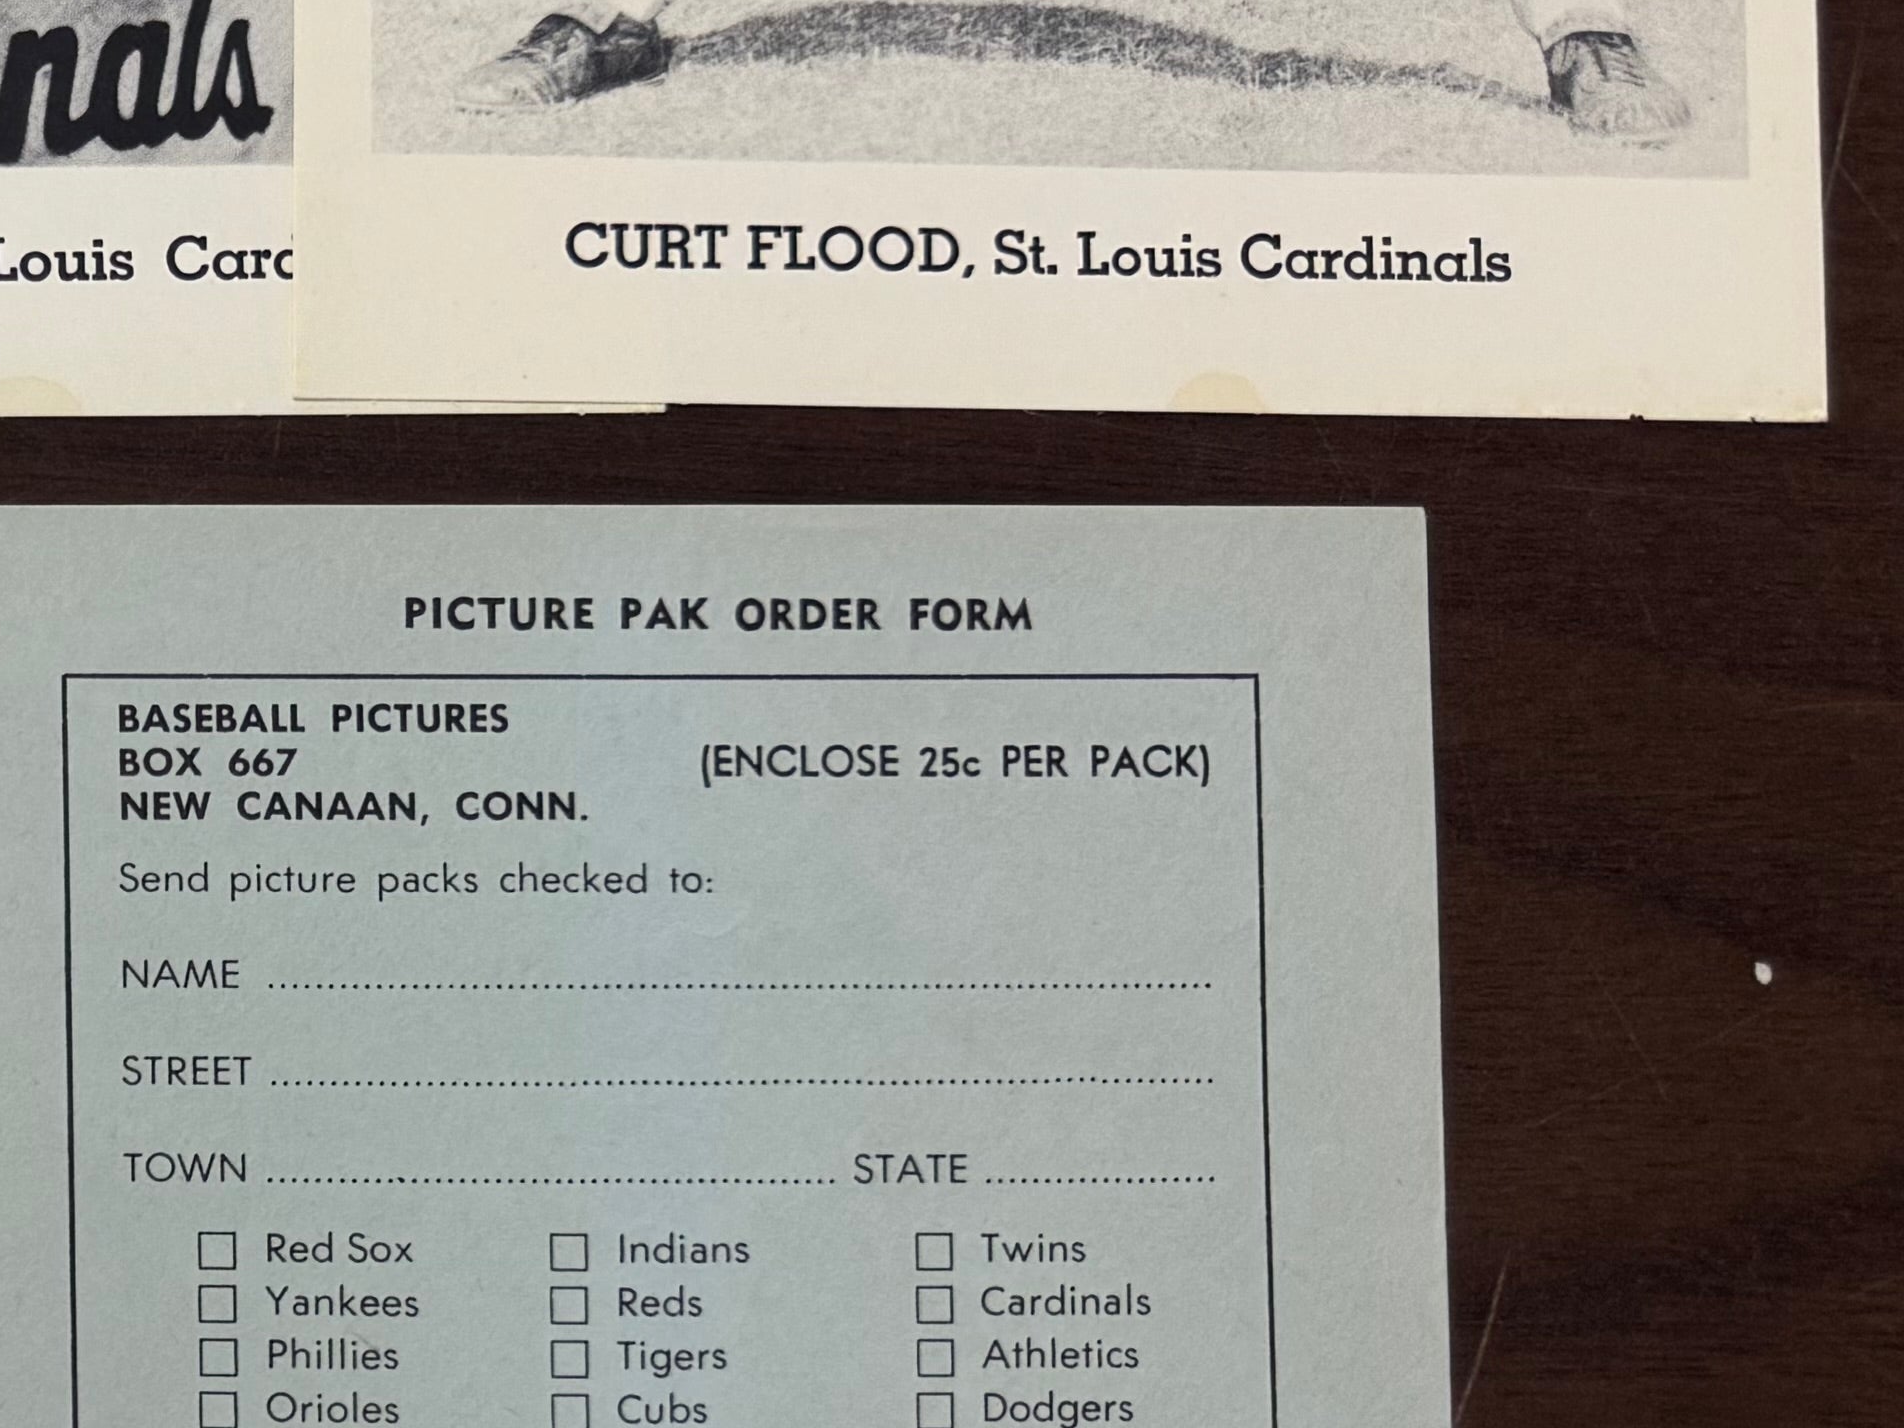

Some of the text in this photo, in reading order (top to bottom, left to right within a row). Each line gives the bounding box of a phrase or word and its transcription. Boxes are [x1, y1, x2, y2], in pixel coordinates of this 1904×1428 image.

[564, 220, 1513, 284] CURT FLOOD, St. Louis Cardinals
[404, 595, 1033, 633] PICTURE PAK ORDER FORM
[117, 702, 509, 734] BASEBALL PICTURES
[118, 746, 298, 778] BOX 667
[700, 743, 1210, 789] (ENCLOSE 25c PER PACK)
[120, 790, 589, 827] NEW CANAAN, CONN.
[118, 860, 714, 903] Send picture packs checked to:
[121, 958, 240, 990] NAME
[121, 1054, 253, 1087] STREET
[122, 1151, 247, 1184] TOWN
[853, 1152, 968, 1185] STATE
[266, 1230, 414, 1264] Red Sox
[619, 1230, 751, 1265] Indians
[979, 1232, 1087, 1264] Twins
[264, 1283, 420, 1318] Yankees
[618, 1284, 704, 1318] Reds
[980, 1282, 1152, 1317] Cardinals
[268, 1336, 400, 1371] Phillies
[616, 1340, 728, 1380] Tigers
[981, 1336, 1140, 1370] Athletics
[265, 1390, 400, 1425] Orioles
[616, 1391, 709, 1426] Cubs
